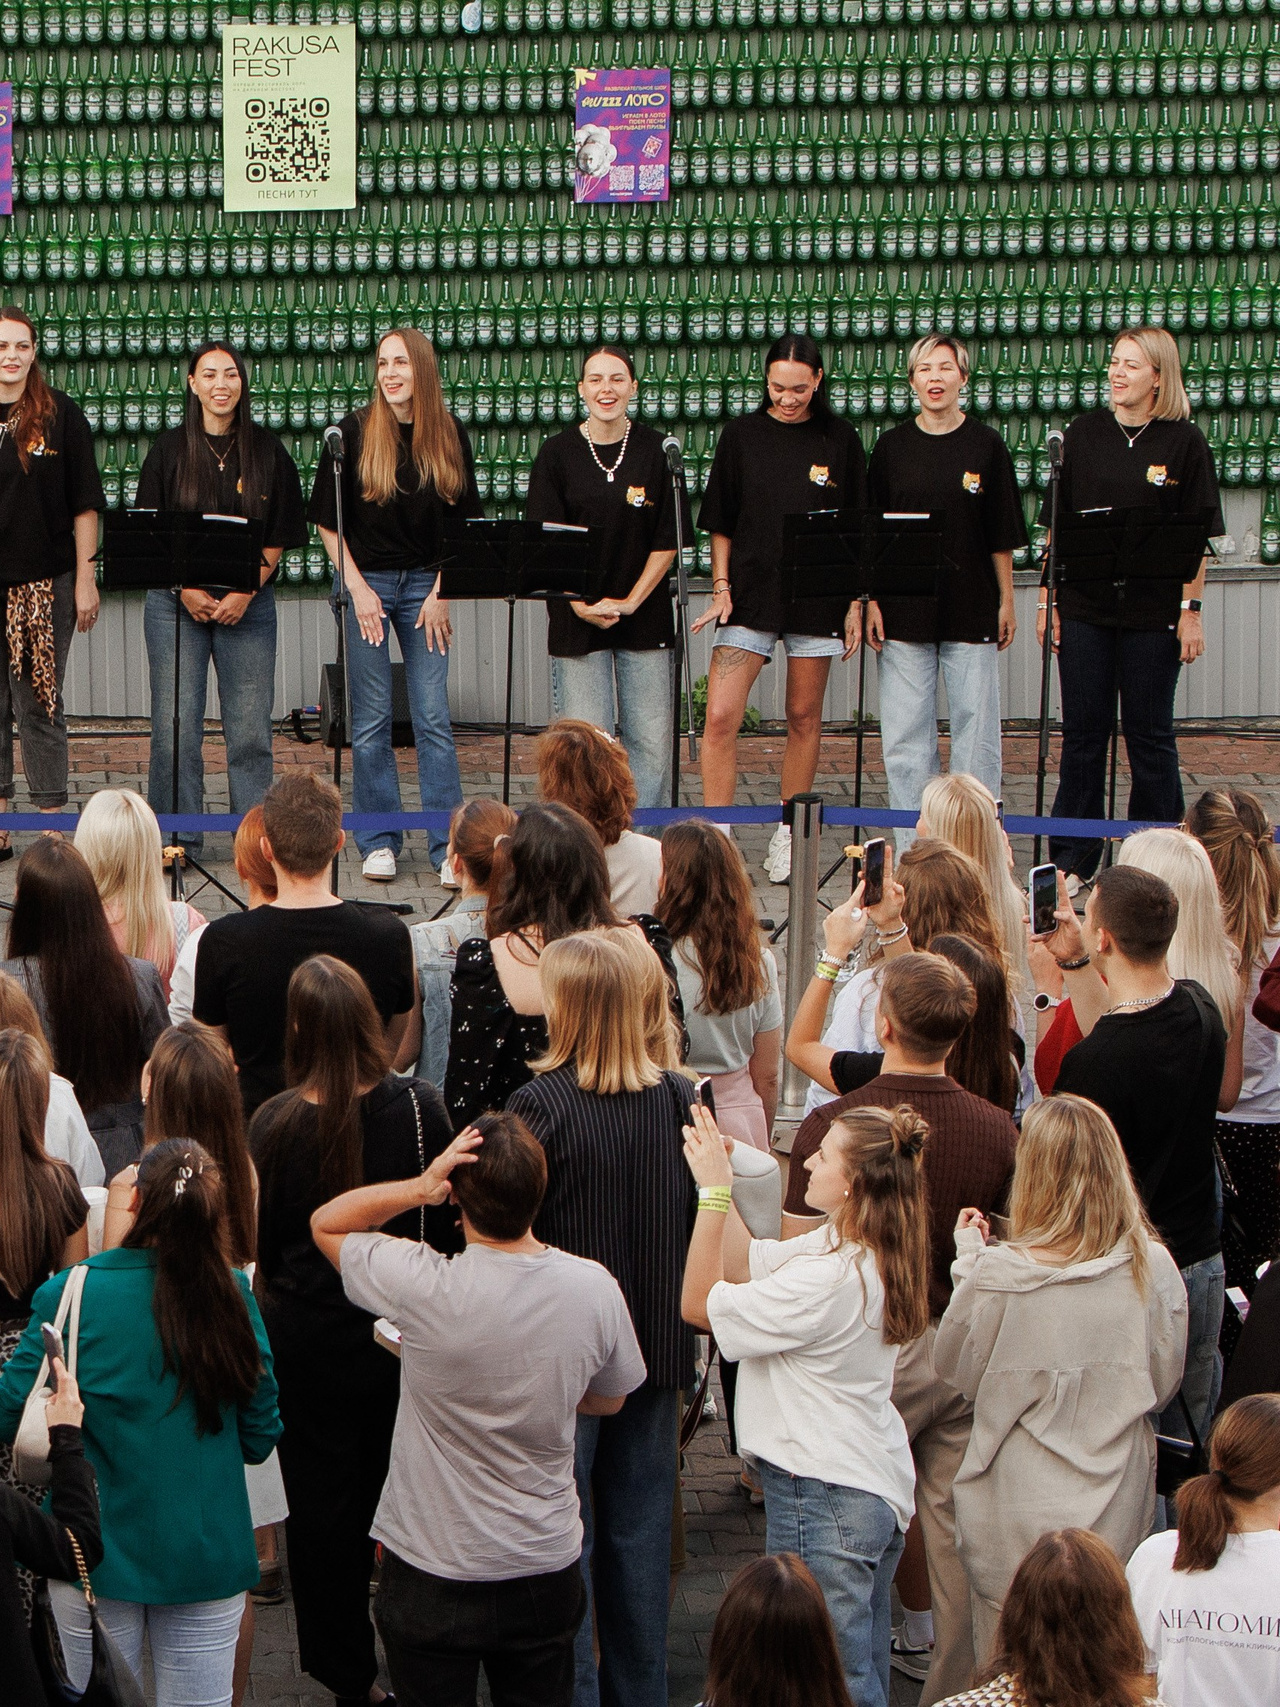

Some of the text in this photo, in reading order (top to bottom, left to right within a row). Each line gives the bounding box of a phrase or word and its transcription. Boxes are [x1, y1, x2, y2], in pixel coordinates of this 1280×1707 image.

[232, 35, 340, 56] RAKUSA
[232, 58, 297, 77] FEST
[624, 92, 665, 107] ЛОТО
[258, 189, 318, 199] ПЕСНИ ТУТ
